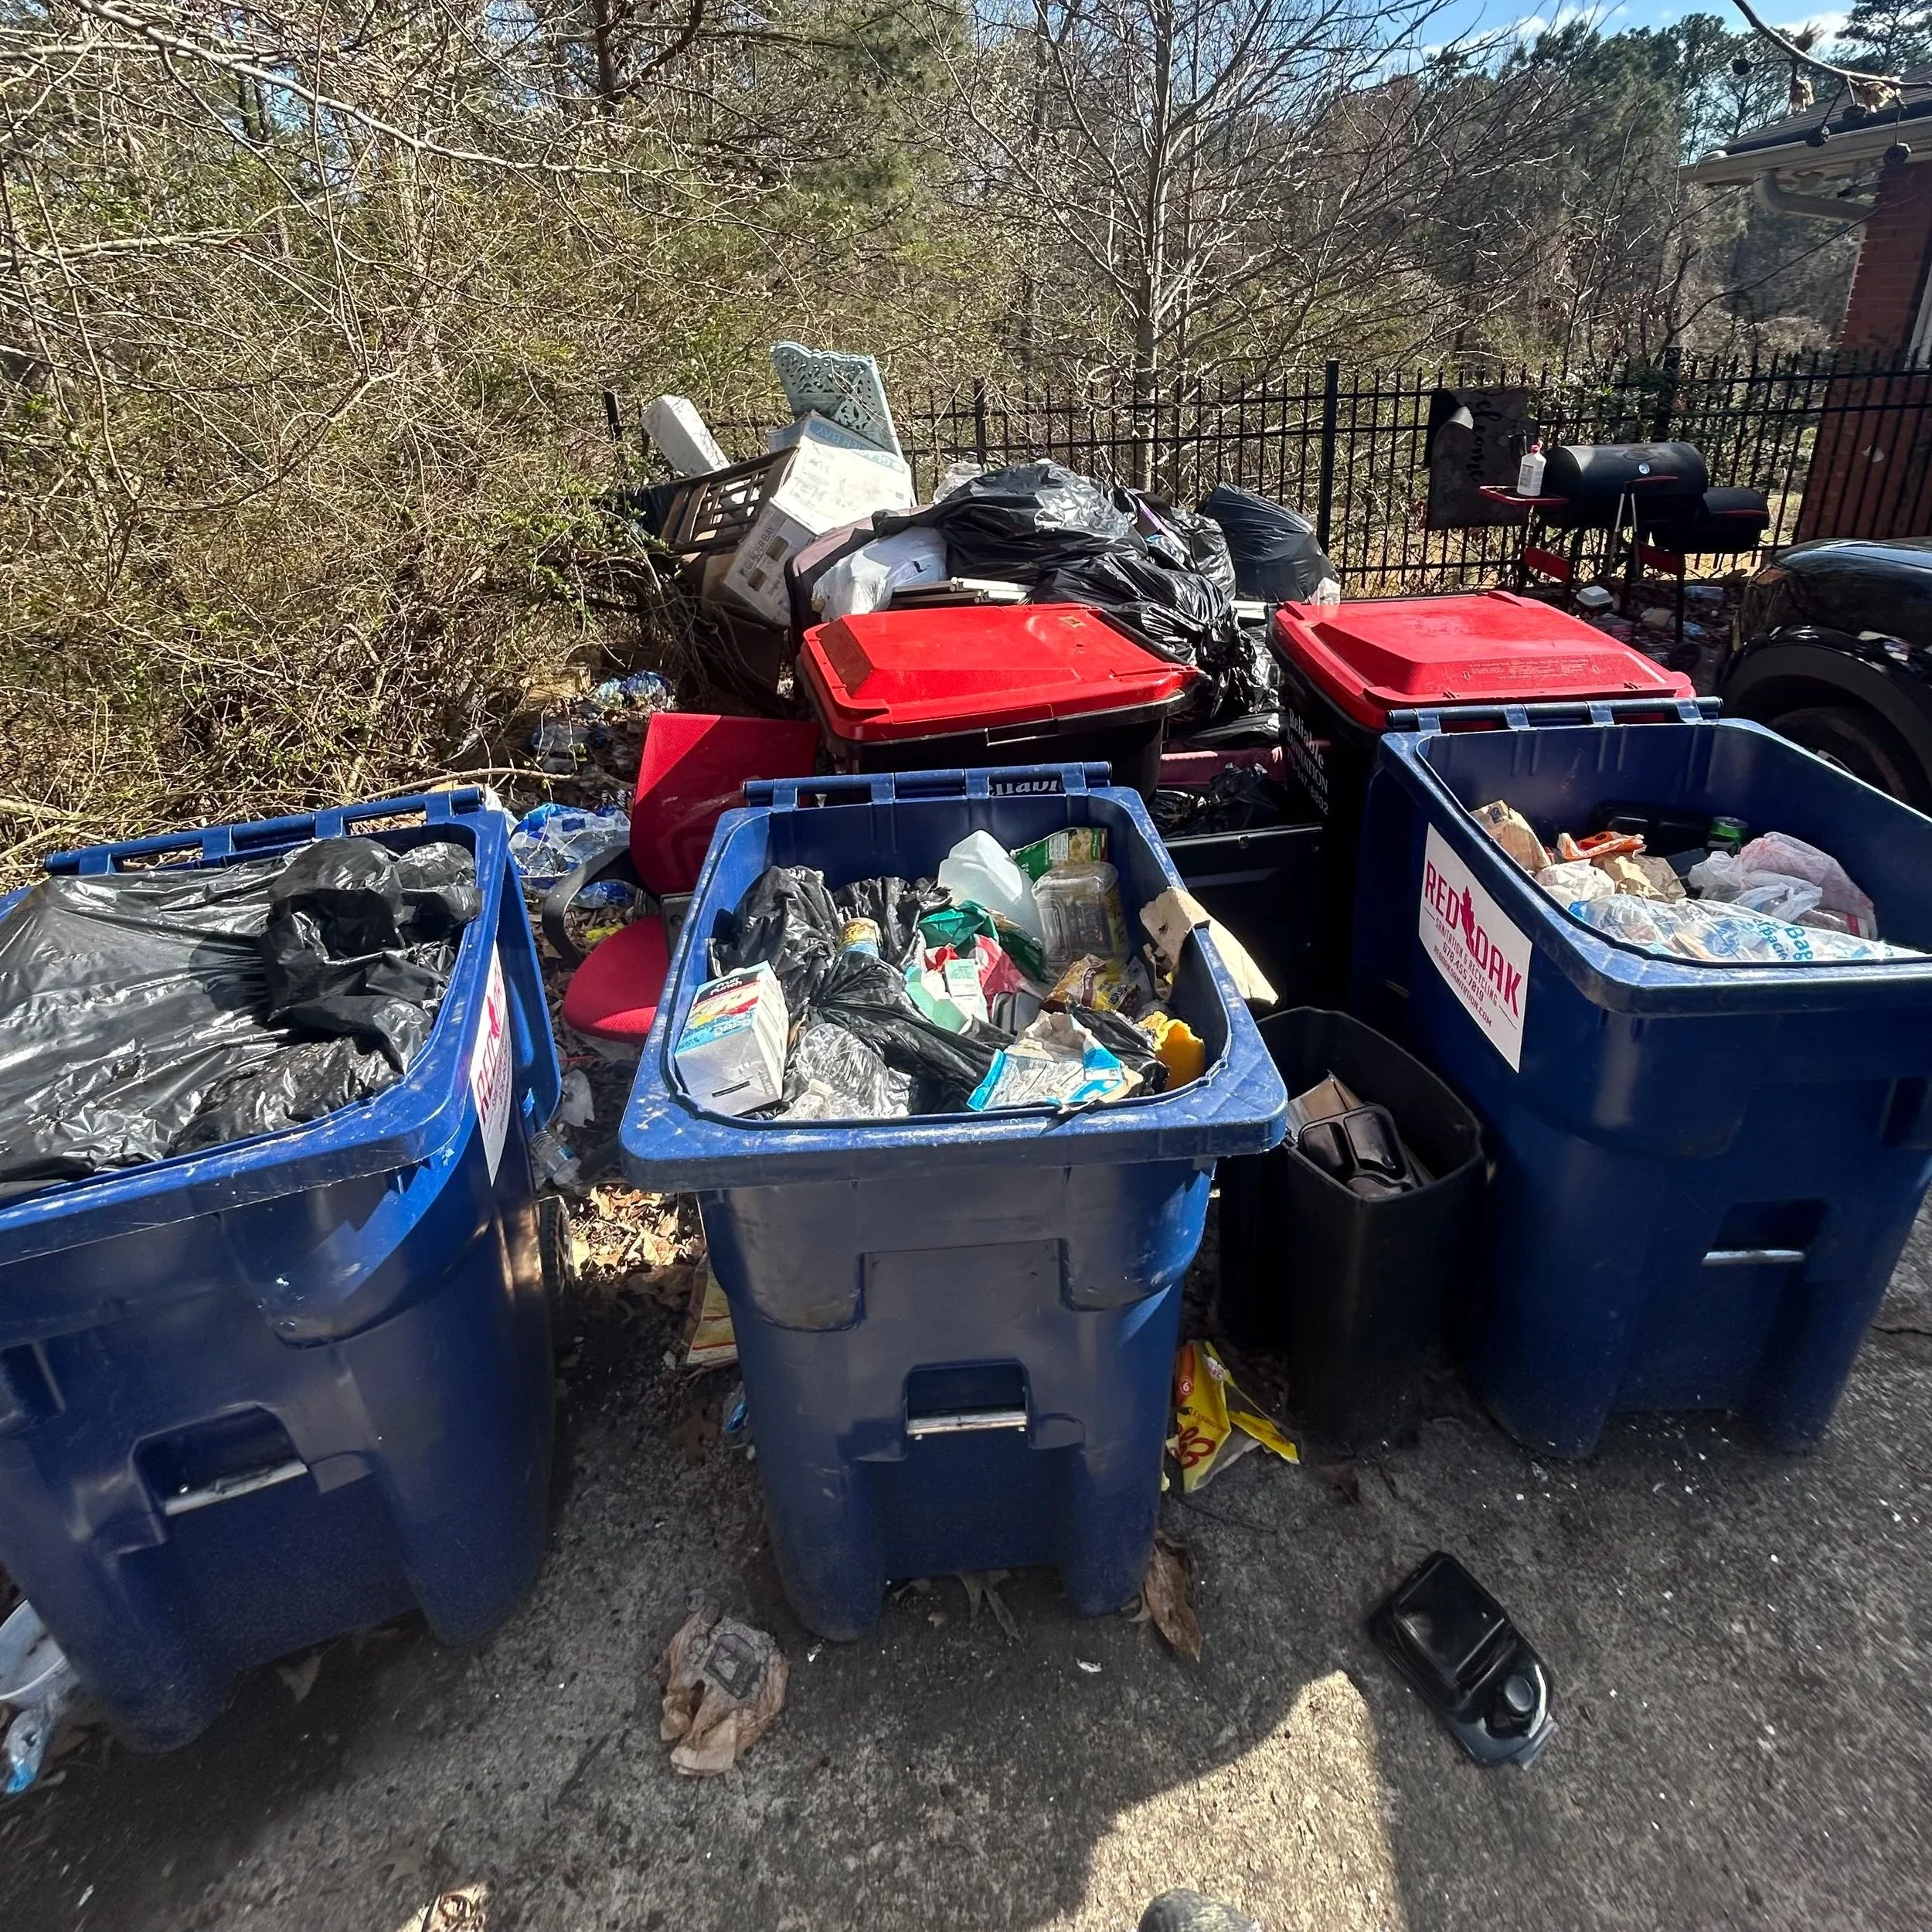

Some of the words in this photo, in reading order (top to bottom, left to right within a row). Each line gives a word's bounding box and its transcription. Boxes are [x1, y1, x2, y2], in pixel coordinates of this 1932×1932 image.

[1288, 707, 1325, 770] Reliable
[1424, 859, 1461, 931] RED
[1475, 926, 1522, 1019] OAK
[1434, 917, 1464, 957] SANITATION
[1468, 959, 1498, 1007] RECYCLING
[1784, 927, 1814, 961] Bag
